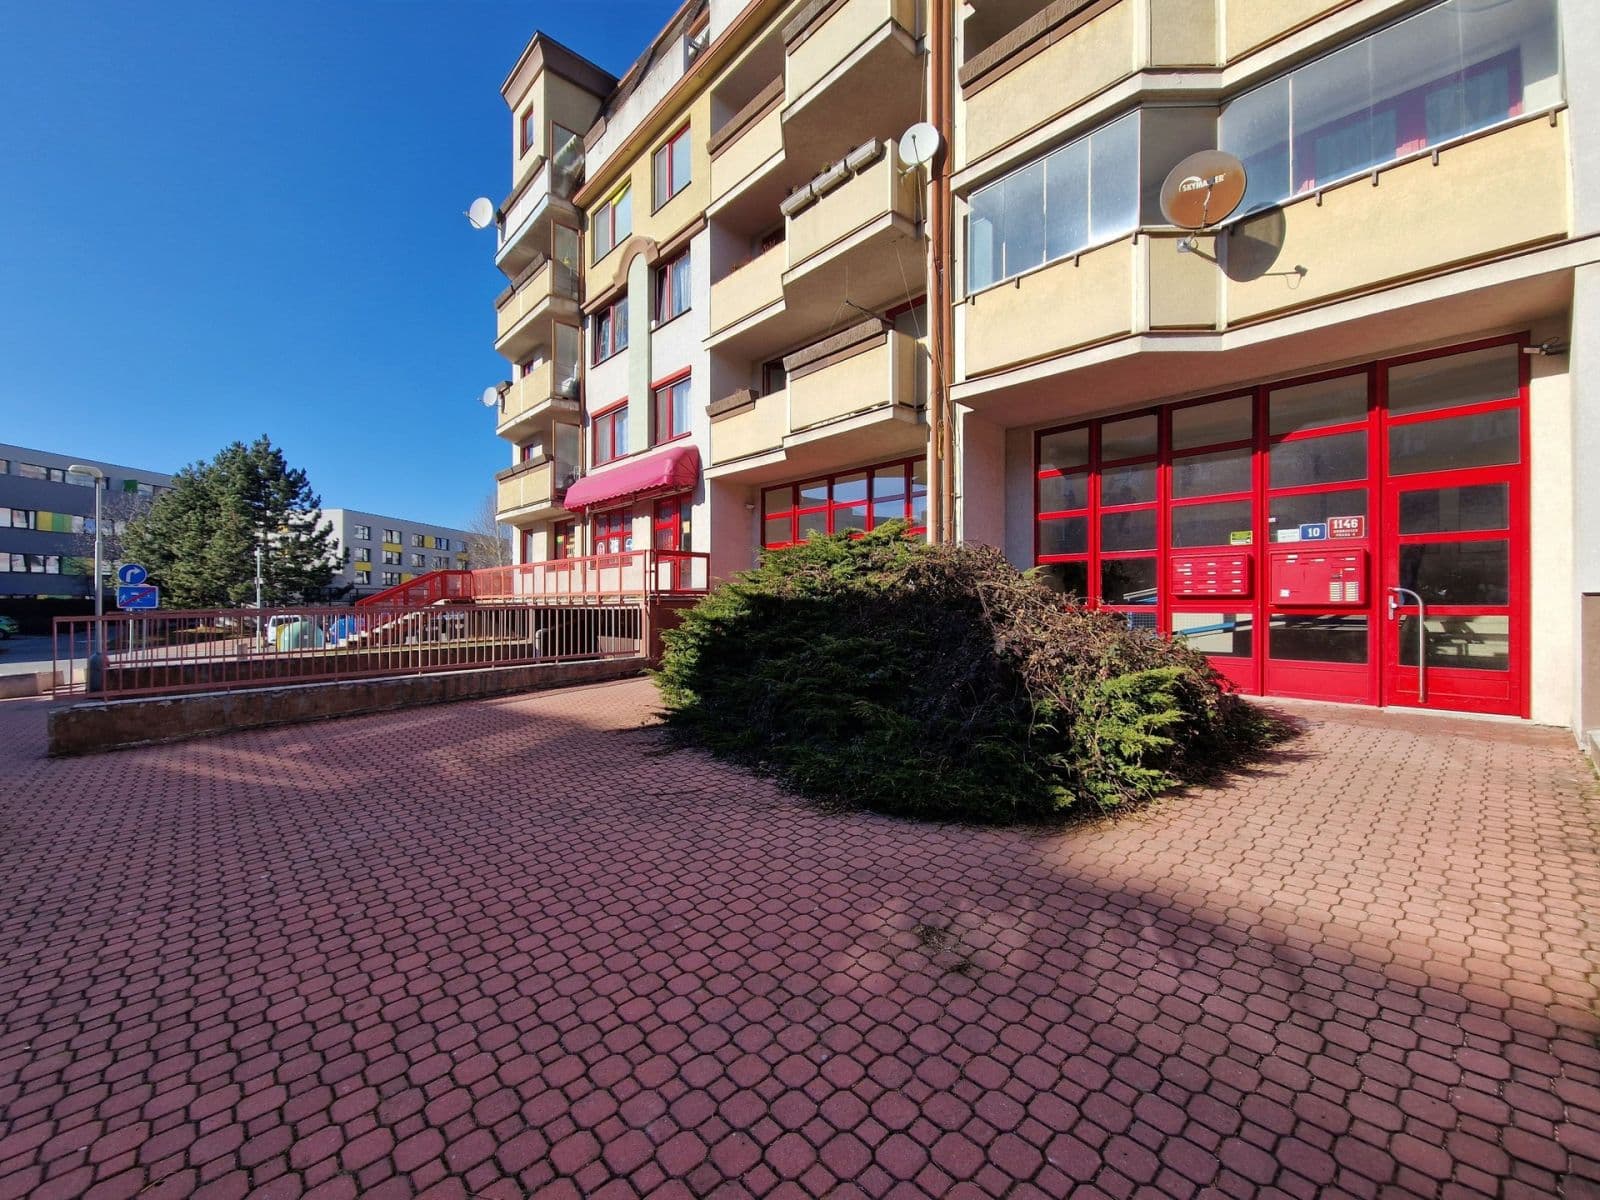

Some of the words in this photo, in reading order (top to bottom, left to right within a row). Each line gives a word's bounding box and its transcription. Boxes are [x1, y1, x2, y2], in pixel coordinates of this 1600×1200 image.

[1182, 174, 1224, 192] SKYMAER
[1333, 518, 1358, 529] 1146
[1308, 527, 1320, 537] 10
